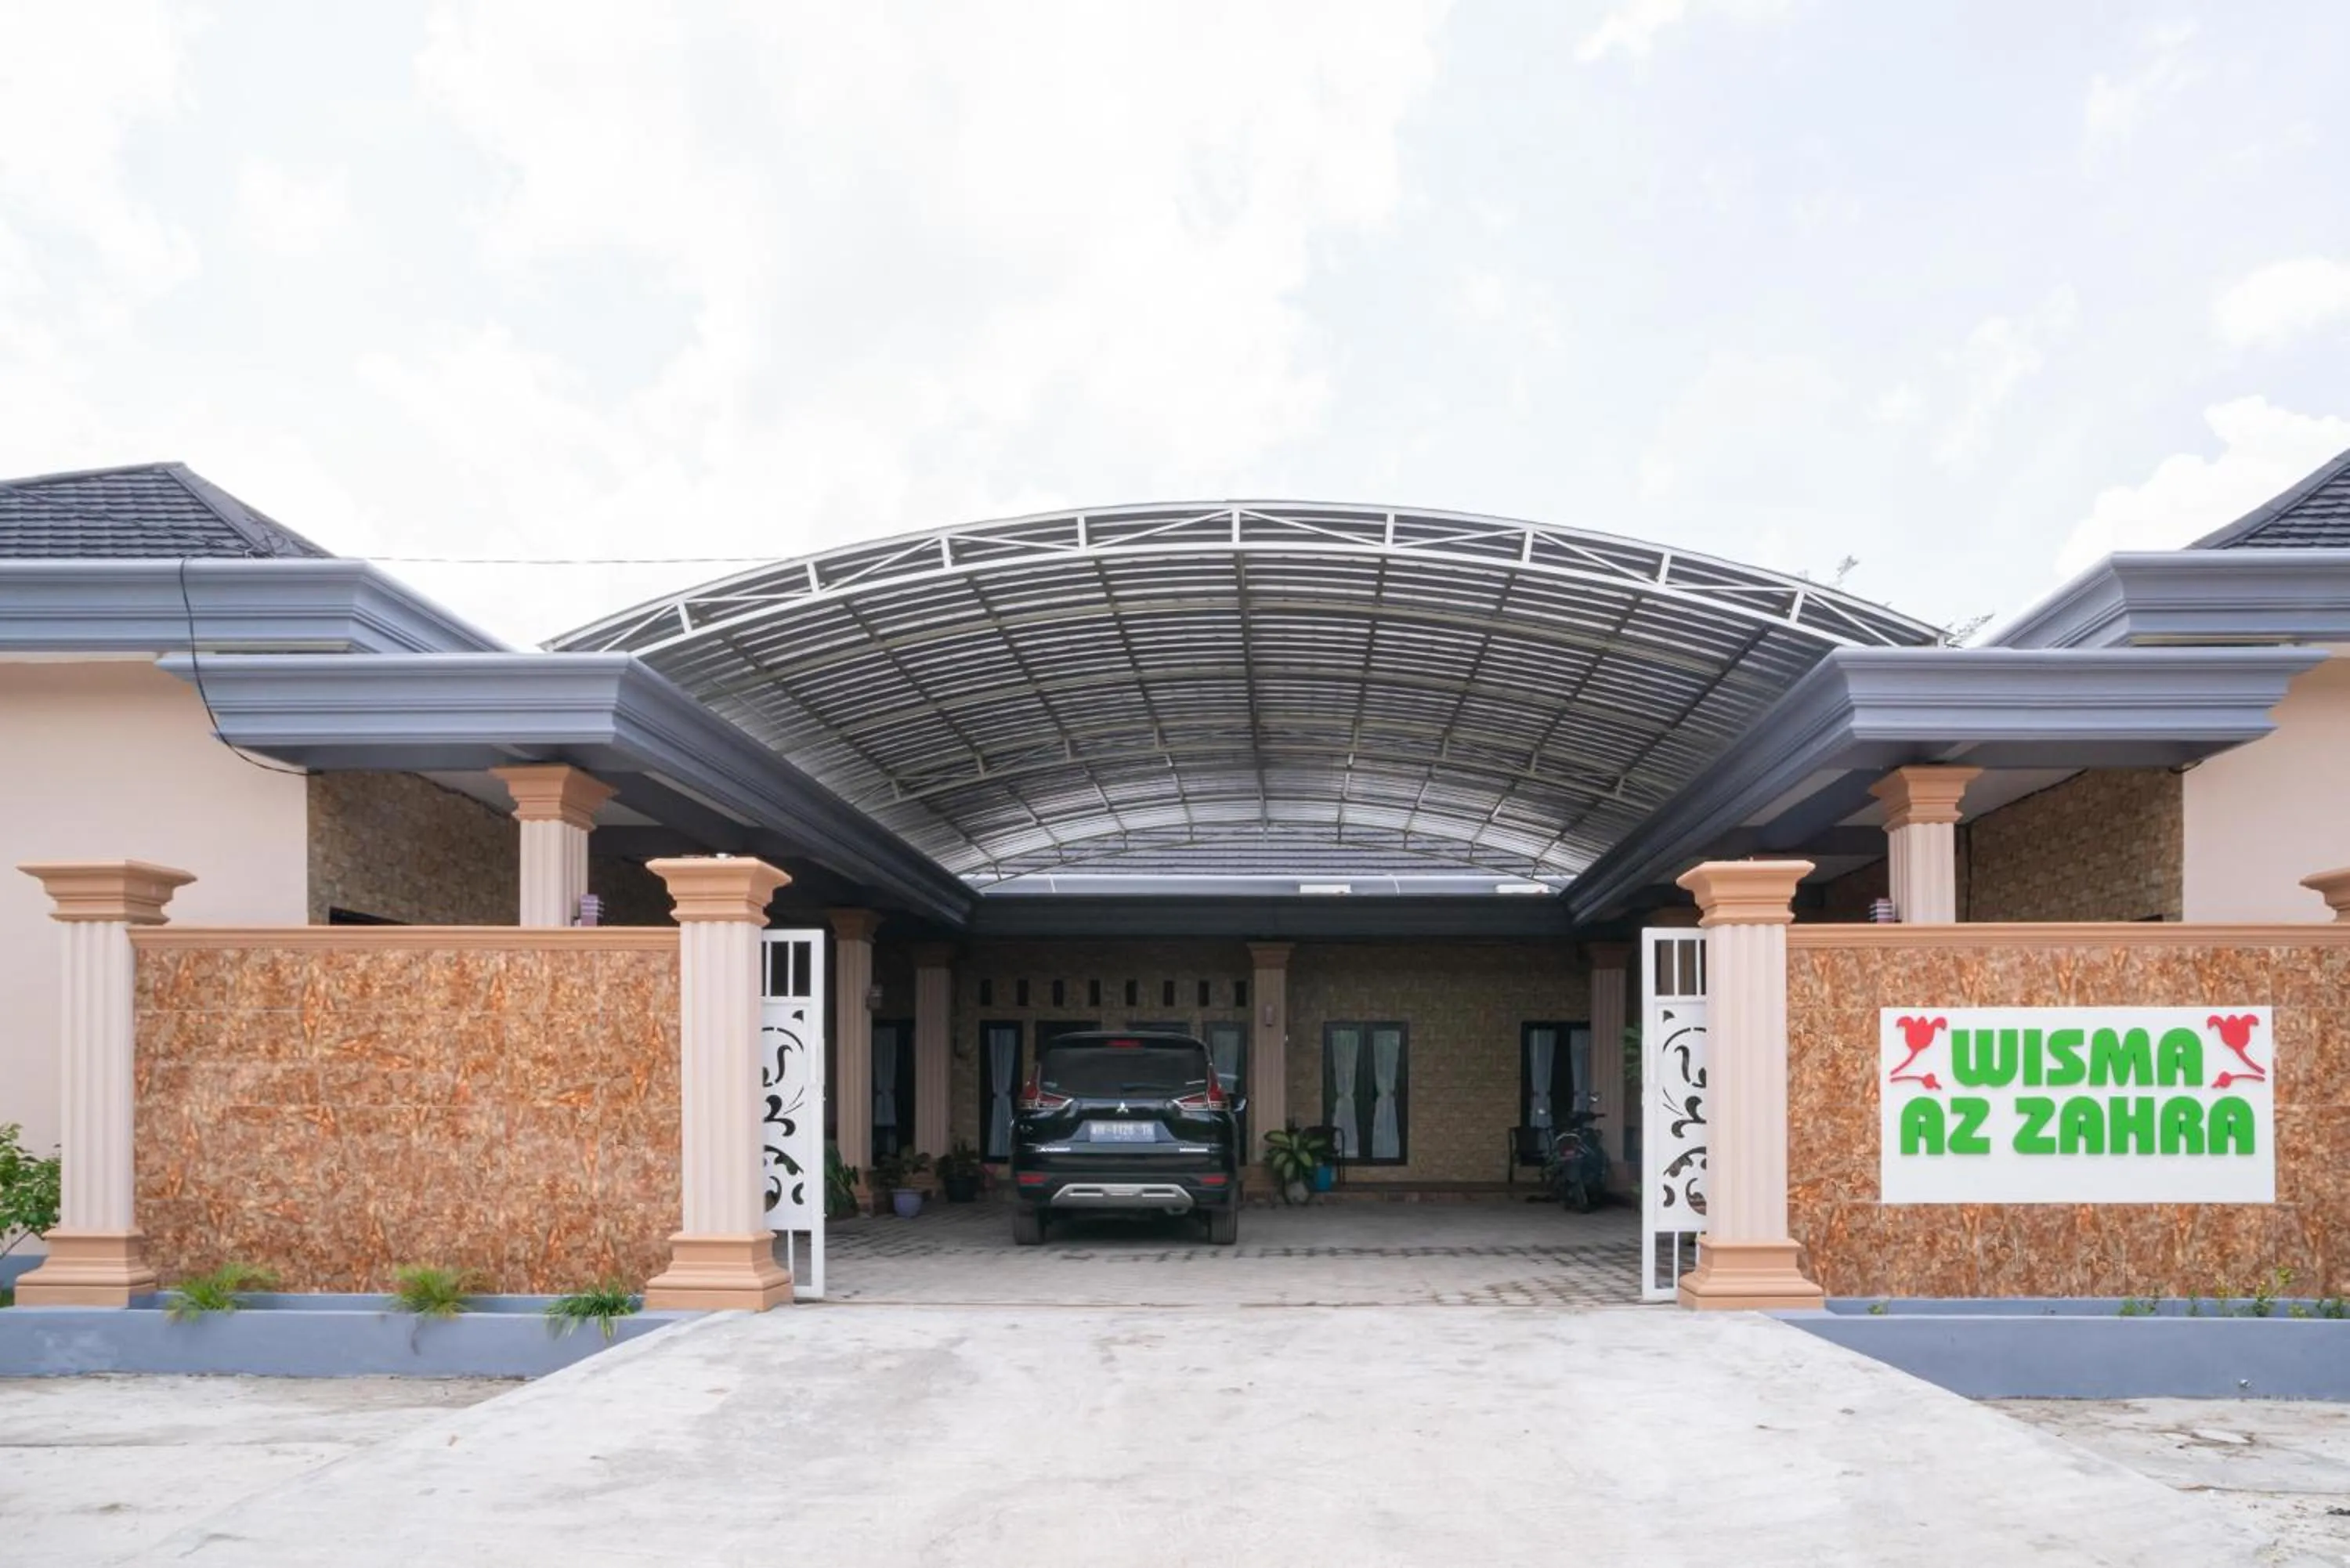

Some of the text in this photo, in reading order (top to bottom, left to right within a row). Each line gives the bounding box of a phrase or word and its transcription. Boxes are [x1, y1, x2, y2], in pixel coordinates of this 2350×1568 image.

[1950, 1027, 2204, 1087] WISMA
[1900, 1096, 2255, 1155] AZ ZAHRA
